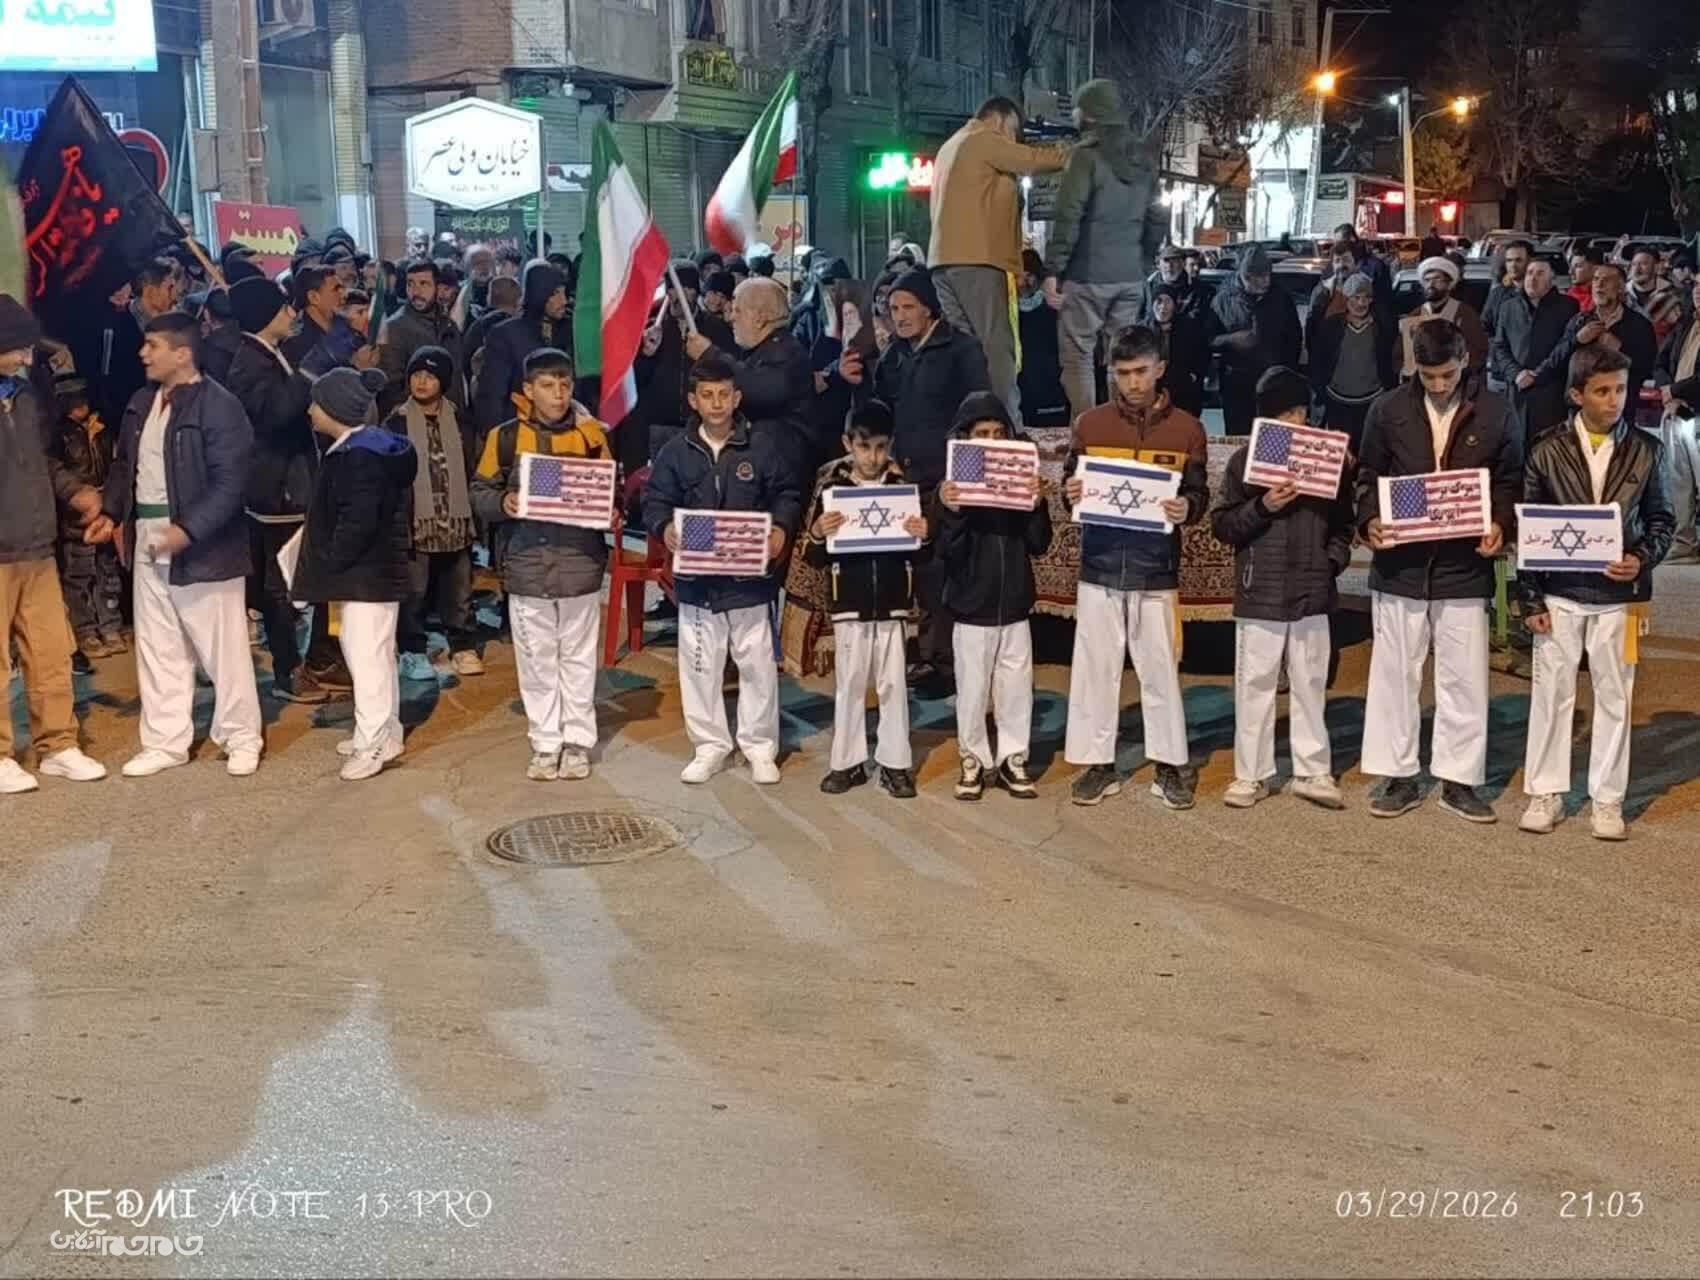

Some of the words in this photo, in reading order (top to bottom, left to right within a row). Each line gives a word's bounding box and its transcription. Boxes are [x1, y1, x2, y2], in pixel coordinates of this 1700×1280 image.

[421, 136, 455, 175] عصر
[448, 141, 477, 176] ولی
[478, 137, 529, 176] خیابان
[1449, 481, 1480, 497] مرگ
[1524, 533, 1554, 546] اسرائیل
[1592, 536, 1615, 546] مرگ
